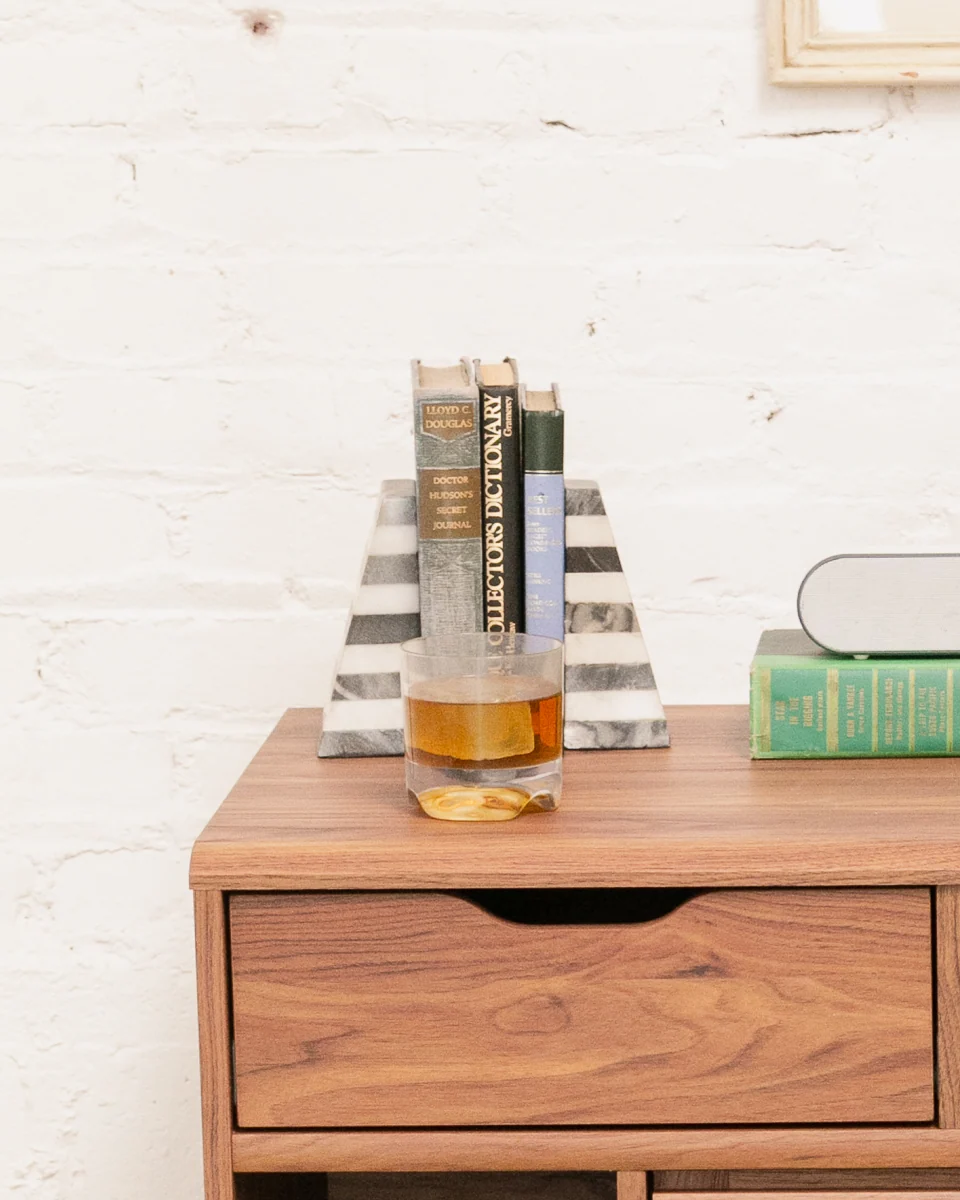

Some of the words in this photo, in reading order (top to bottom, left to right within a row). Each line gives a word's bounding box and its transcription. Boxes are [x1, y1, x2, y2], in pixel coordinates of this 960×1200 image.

[426, 405, 459, 415] LLOYD
[461, 405, 471, 415] C.
[503, 396, 513, 437] Gramercy
[425, 419, 473, 429] DOUGLAS
[484, 393, 503, 519] DICTIONARY
[433, 475, 469, 485] DOCTOR
[429, 490, 473, 500] HUDSON'S
[437, 505, 468, 515] SECRET
[433, 521, 472, 530] JOURNAL
